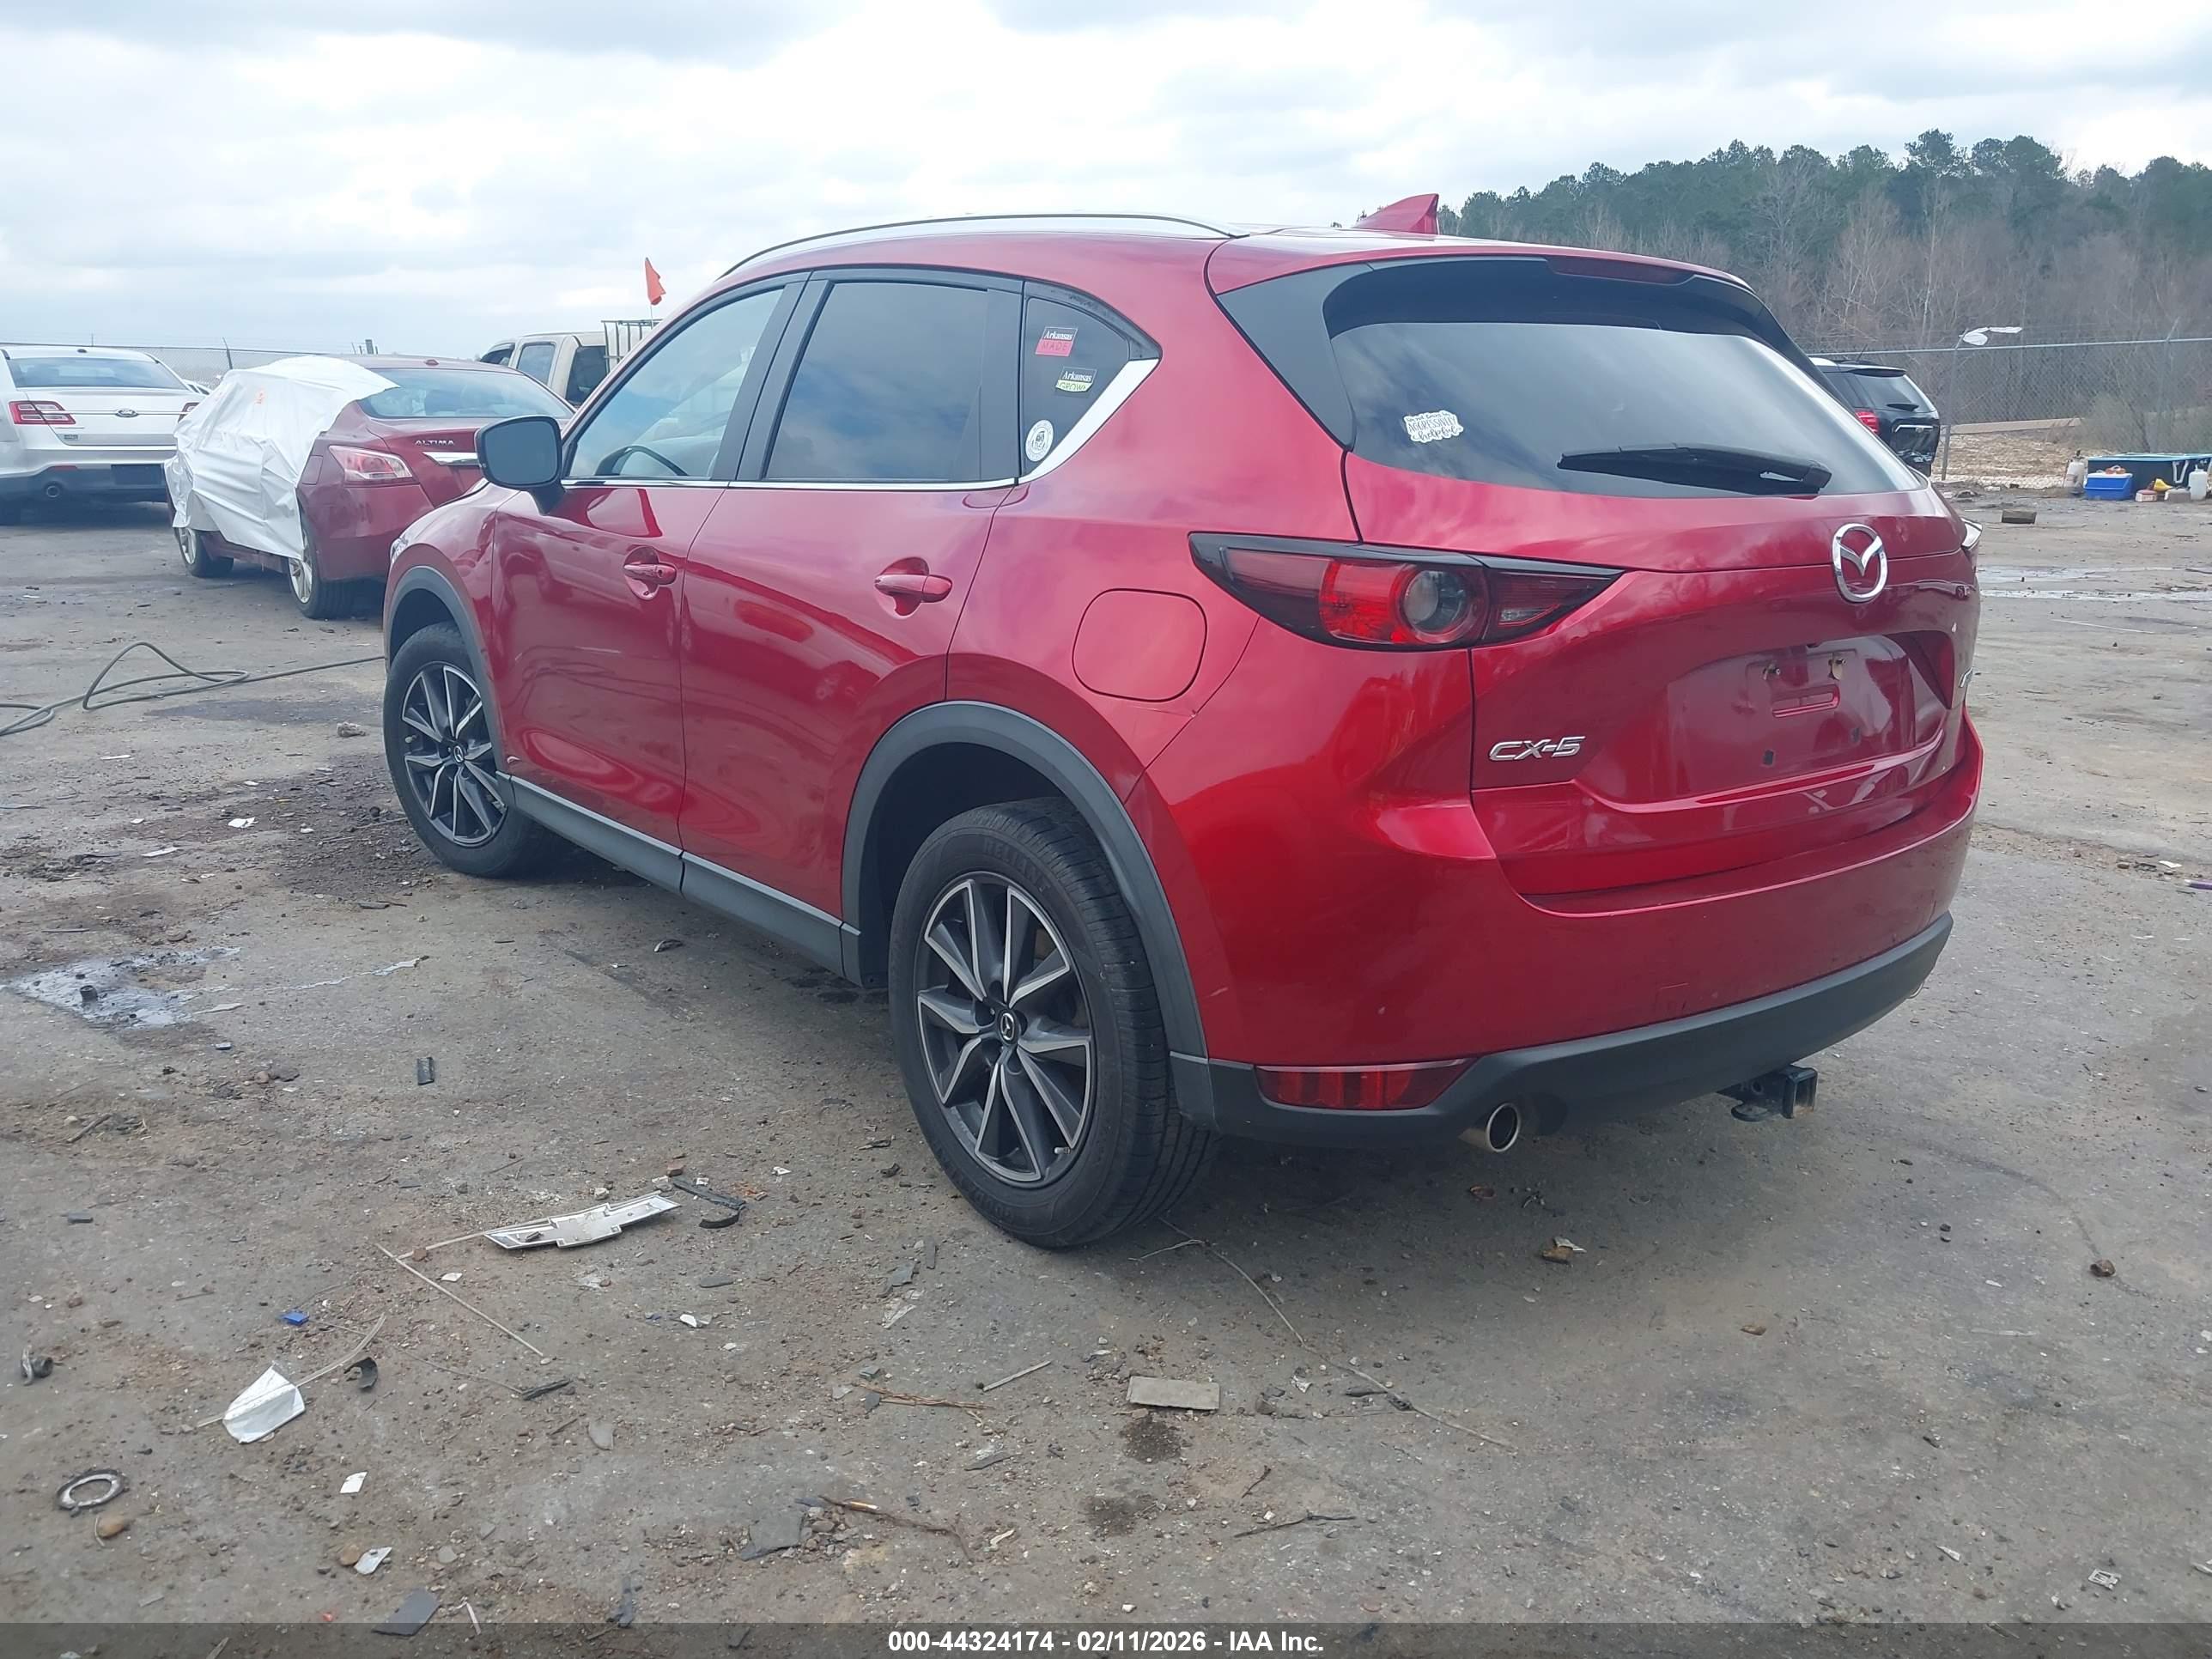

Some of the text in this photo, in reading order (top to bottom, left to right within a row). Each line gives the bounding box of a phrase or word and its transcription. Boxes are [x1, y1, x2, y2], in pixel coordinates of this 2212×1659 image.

[1043, 331, 1073, 340] Arkansas
[1040, 340, 1070, 351] MADE
[1062, 370, 1092, 382] Arkansas
[1489, 735, 1587, 761] CX-5
